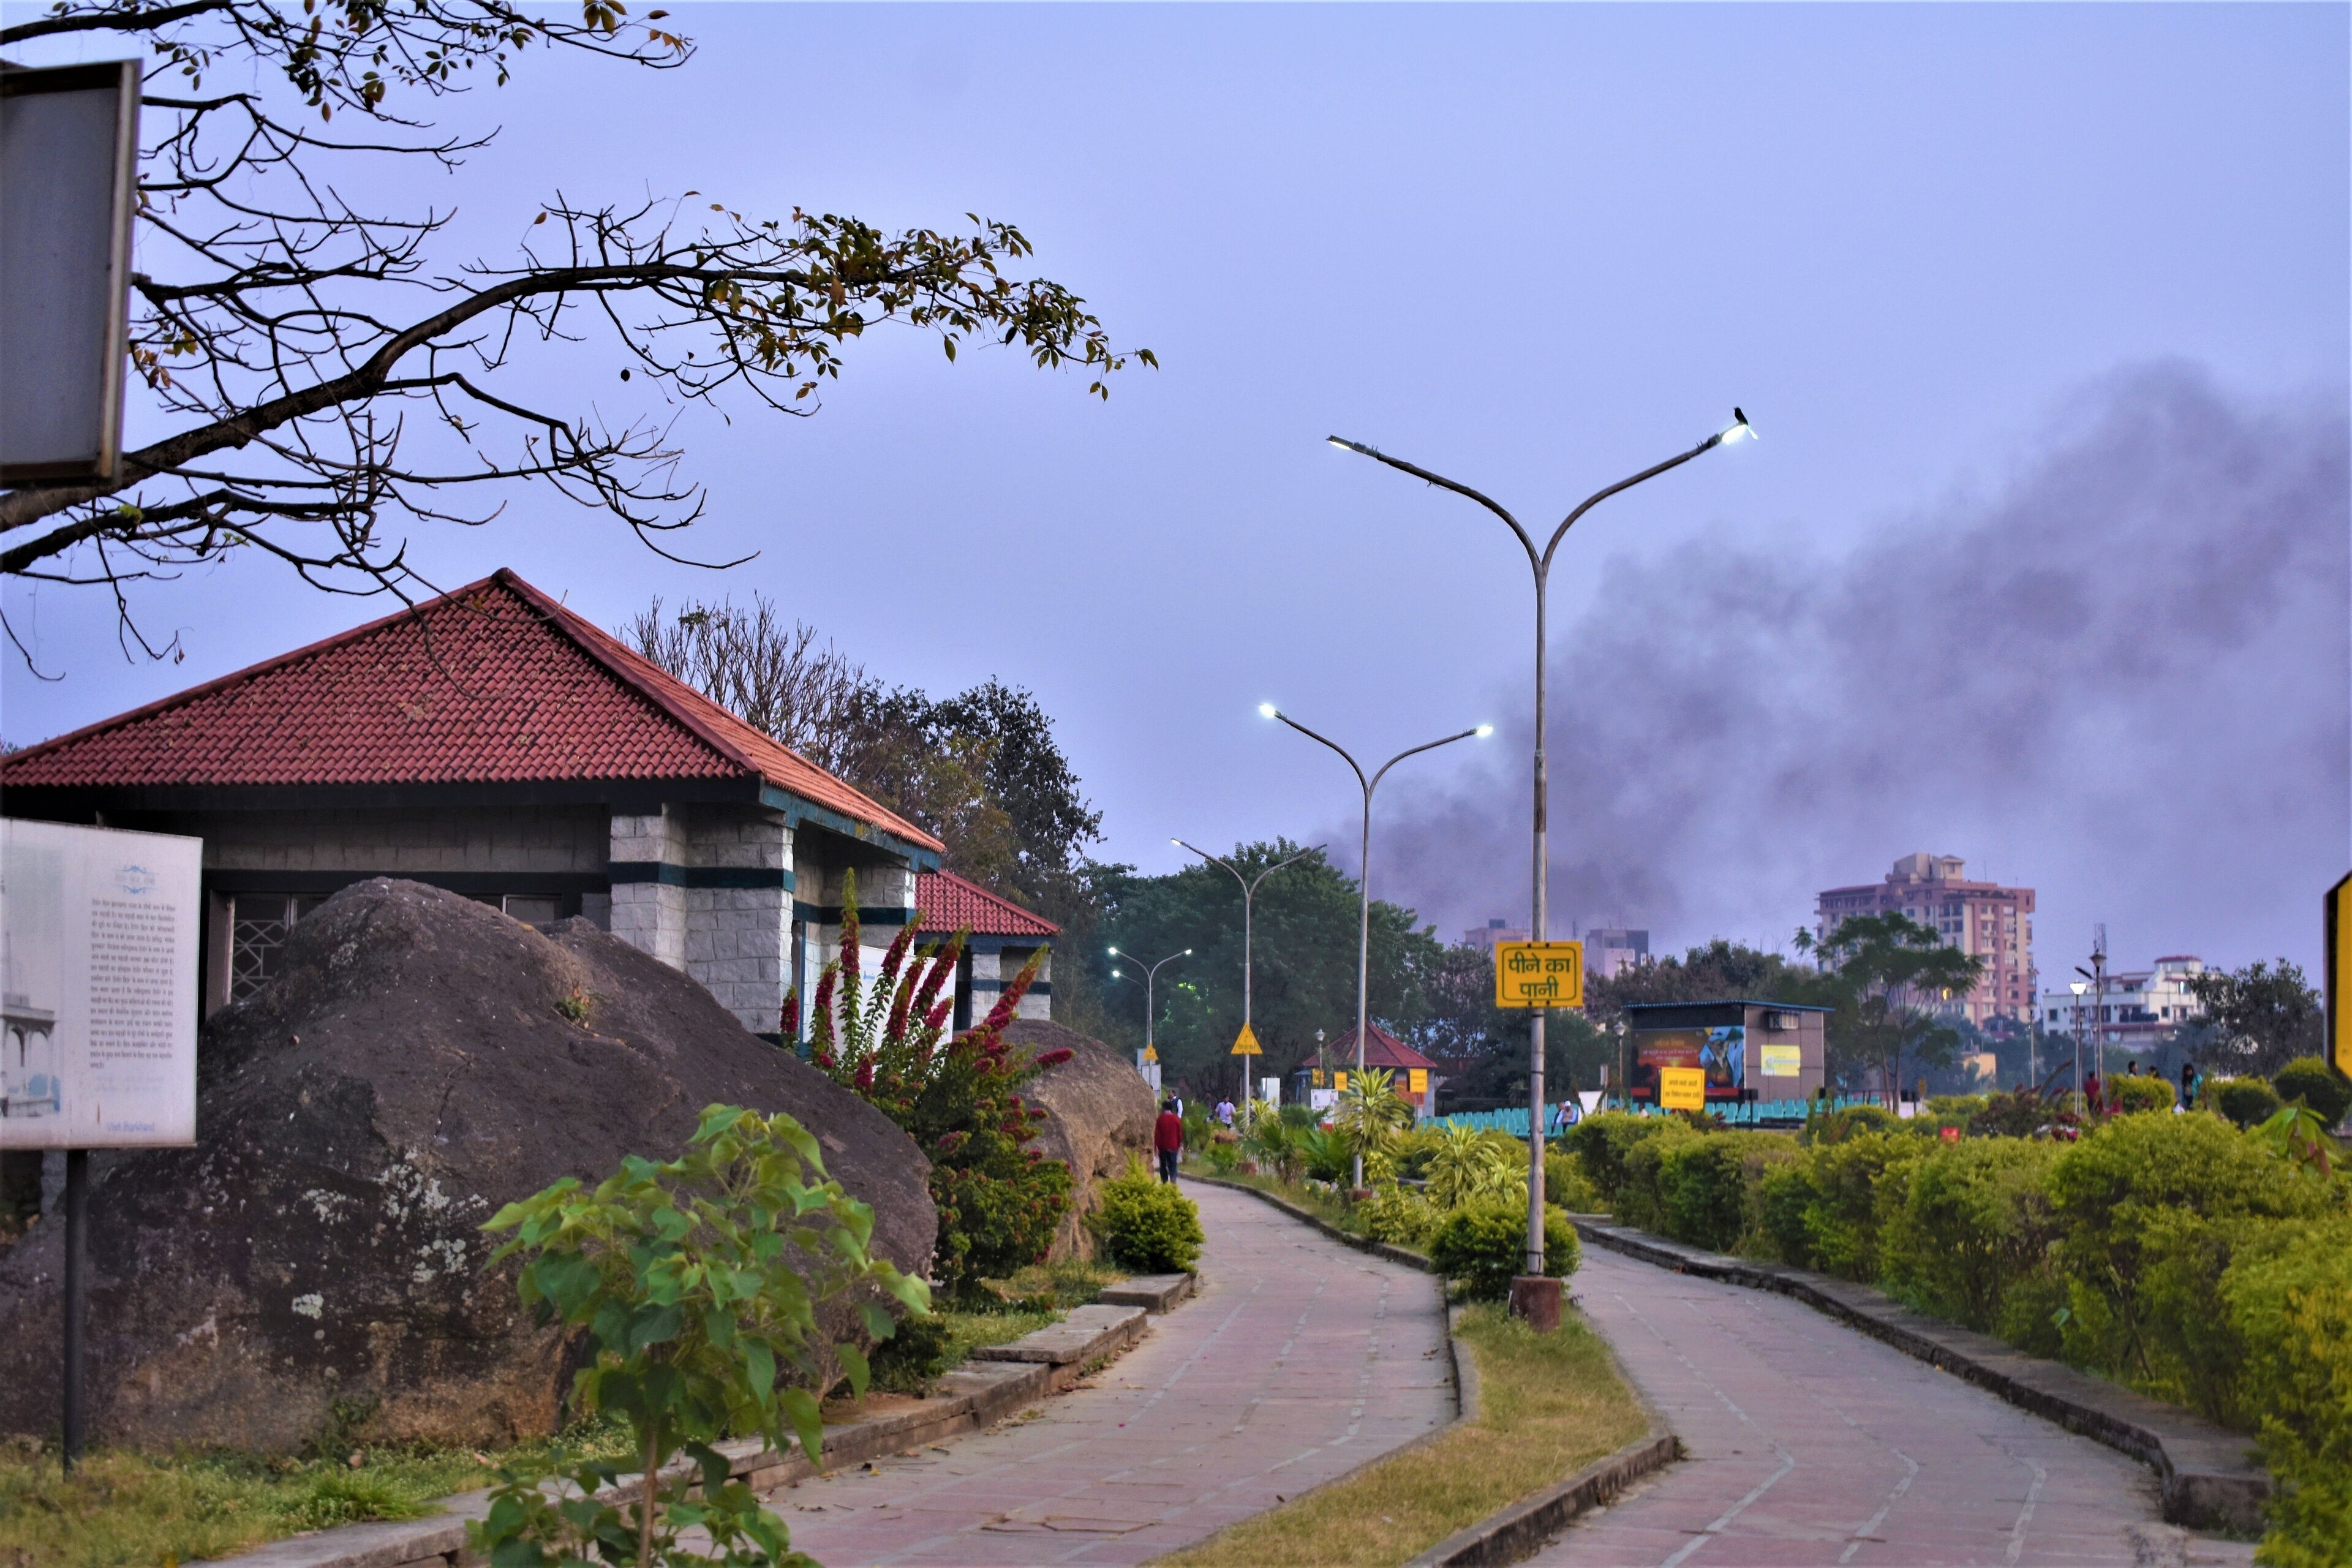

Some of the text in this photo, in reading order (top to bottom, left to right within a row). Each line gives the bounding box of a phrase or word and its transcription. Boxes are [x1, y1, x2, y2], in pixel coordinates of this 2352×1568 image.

[1508, 951, 1570, 973] पीने का
[1519, 975, 1559, 997] पानी
